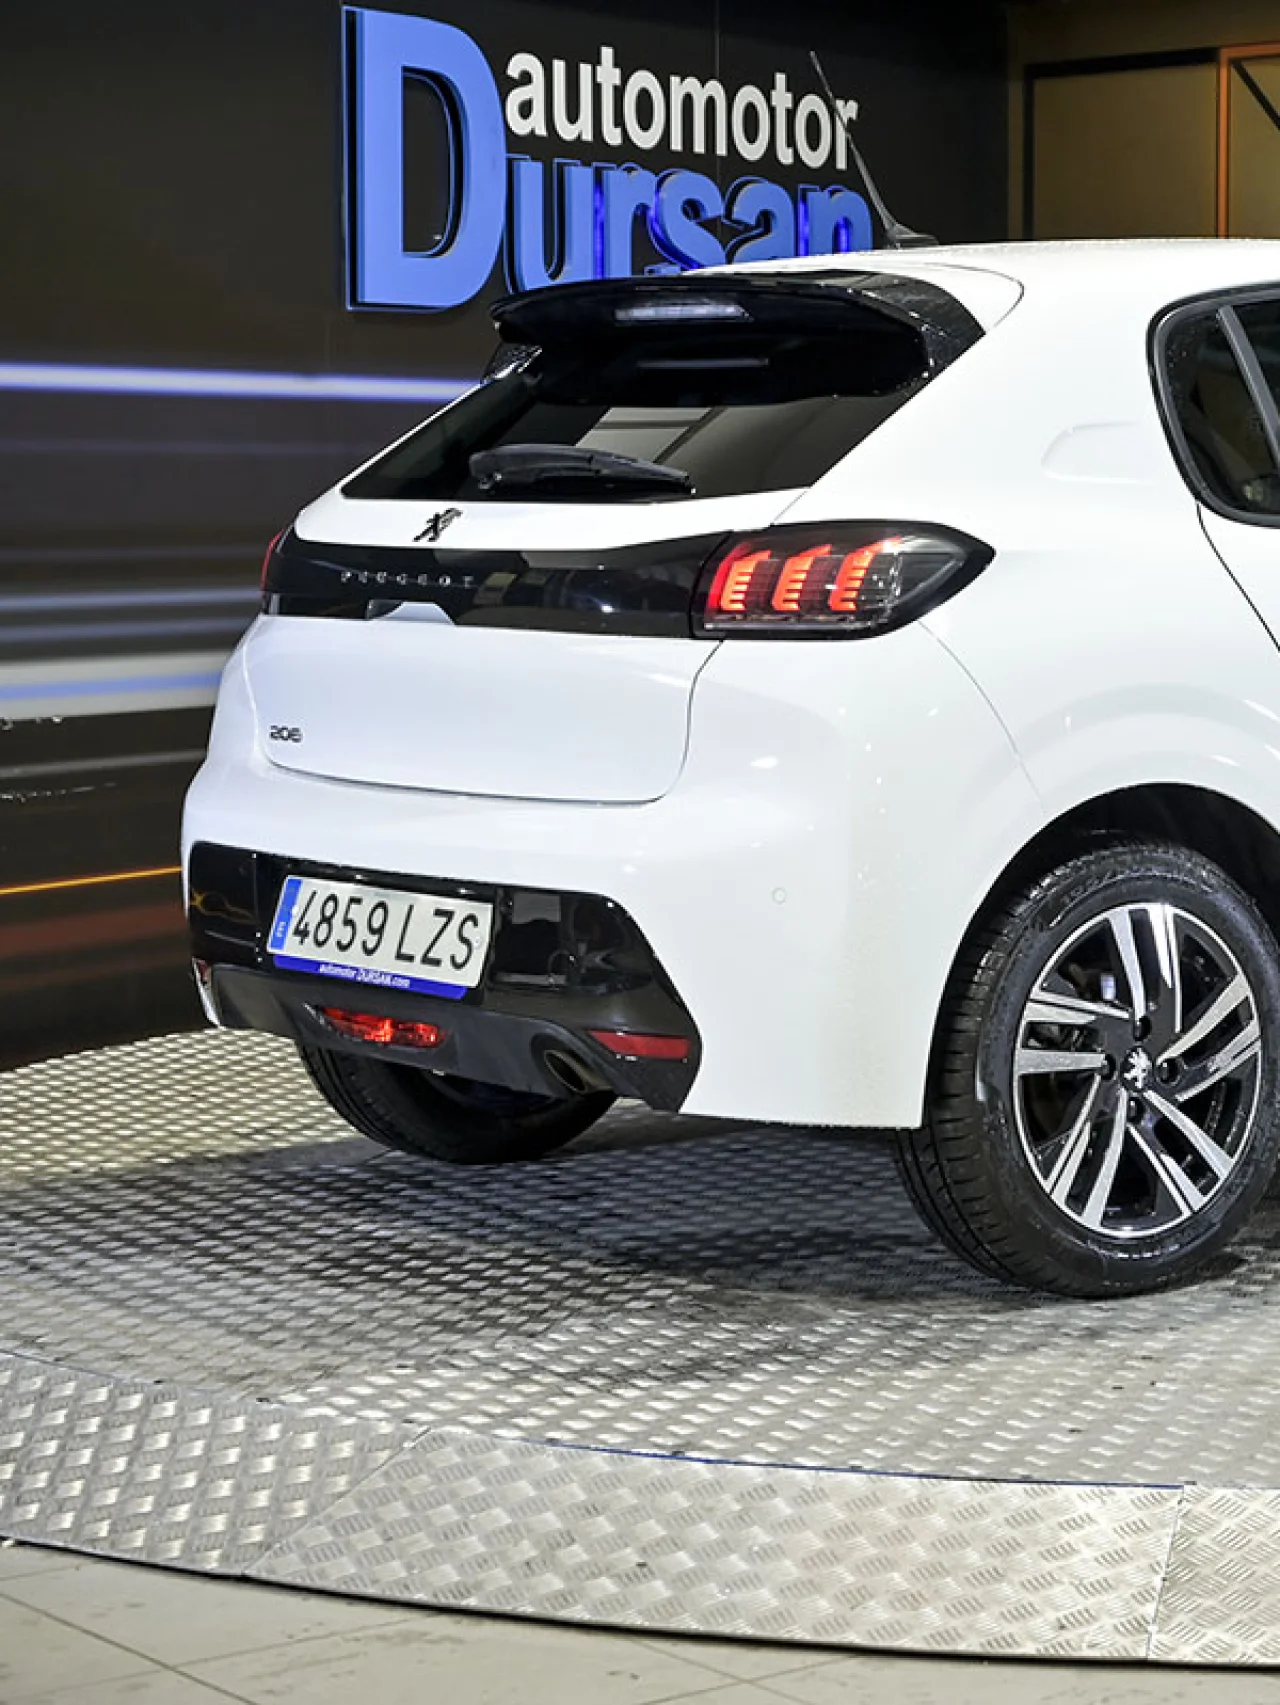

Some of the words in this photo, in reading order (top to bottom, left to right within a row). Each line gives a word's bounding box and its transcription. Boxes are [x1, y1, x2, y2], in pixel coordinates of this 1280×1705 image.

[343, 5, 873, 312] Dursan
[505, 46, 858, 170] automotor
[340, 570, 474, 589] PEUGEOT
[292, 889, 389, 957] 4859
[394, 903, 479, 970] LZS
